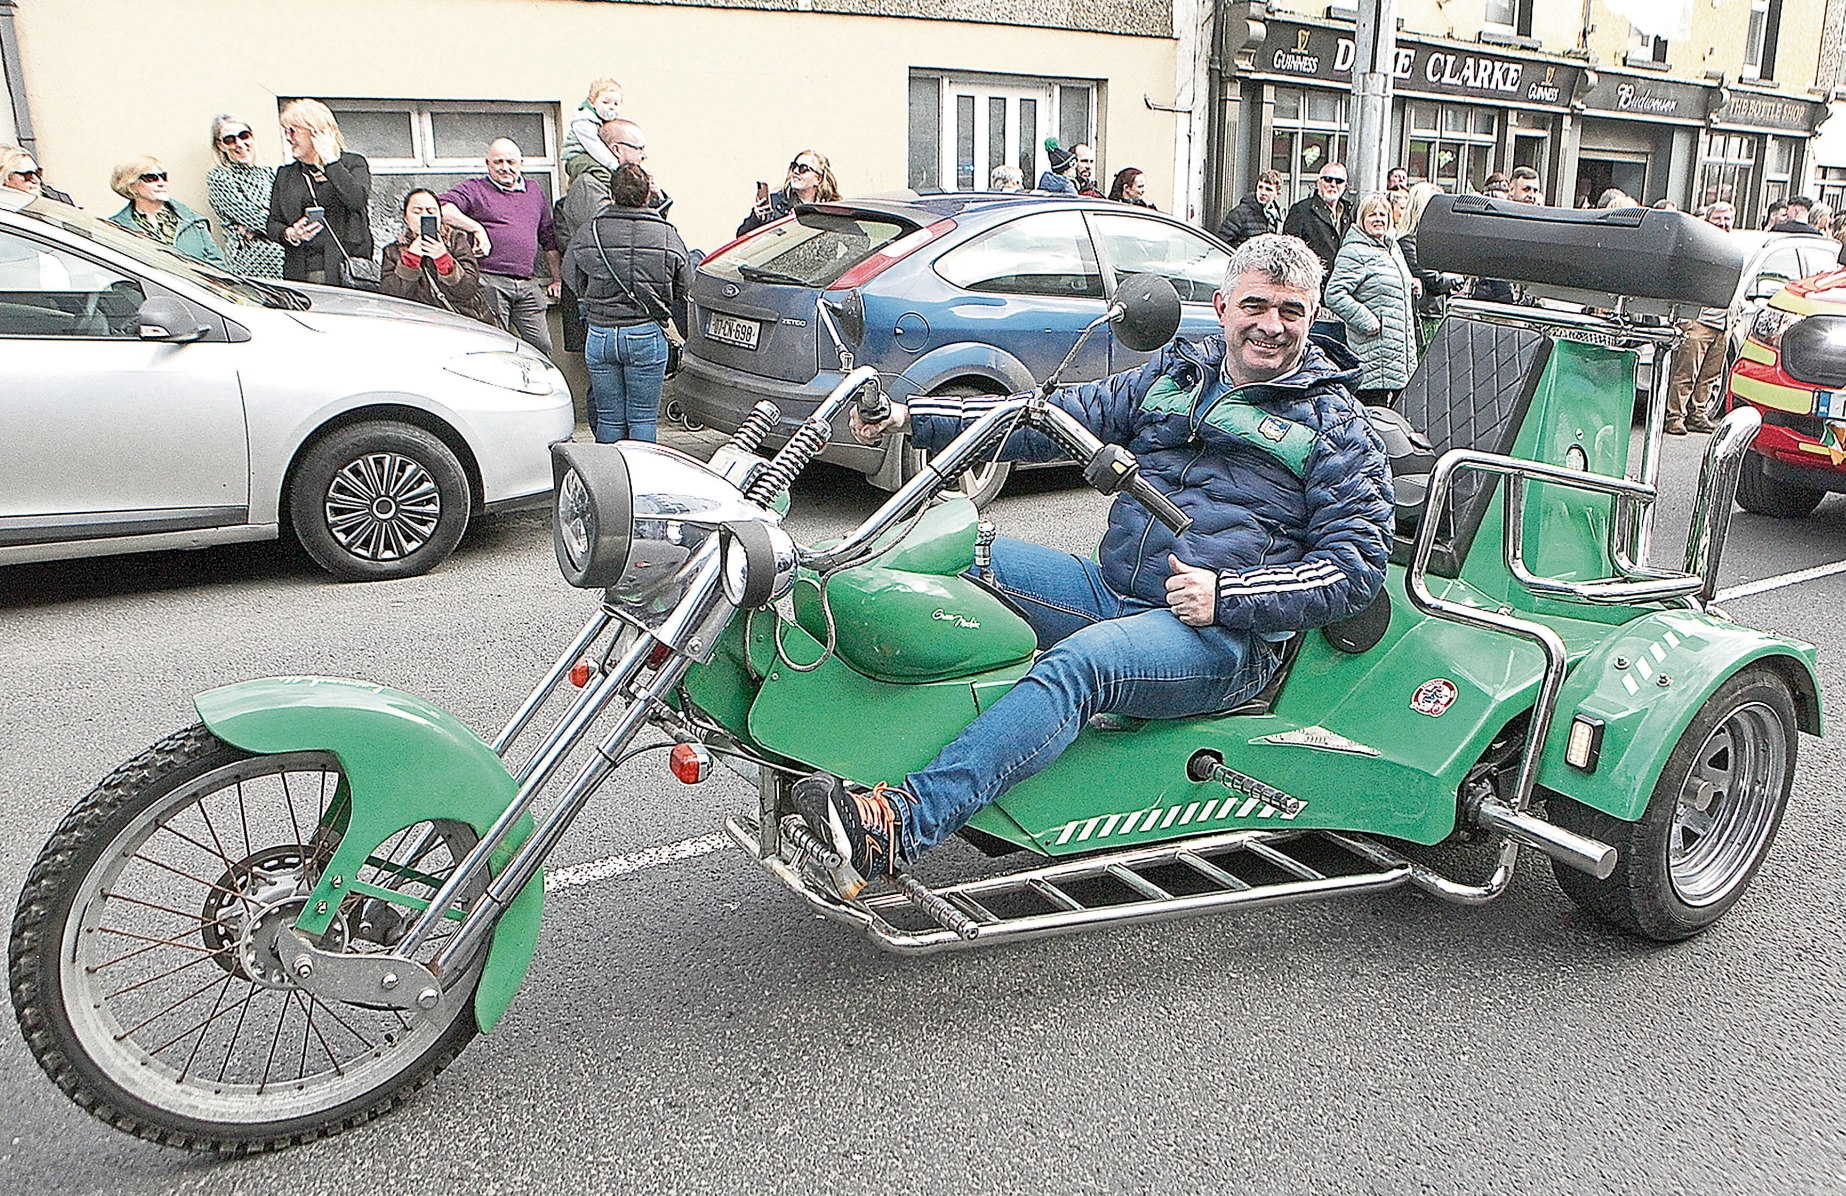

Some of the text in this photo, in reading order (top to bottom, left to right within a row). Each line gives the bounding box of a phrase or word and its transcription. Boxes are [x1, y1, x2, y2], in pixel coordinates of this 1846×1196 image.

[1273, 49, 1319, 74] GUINNESS
[1333, 37, 1524, 93] DE CLARKE
[1527, 82, 1560, 102] GUINNESS
[1617, 83, 1678, 112] Budweiser
[1729, 97, 1806, 121] THE BOTTLE SHOP
